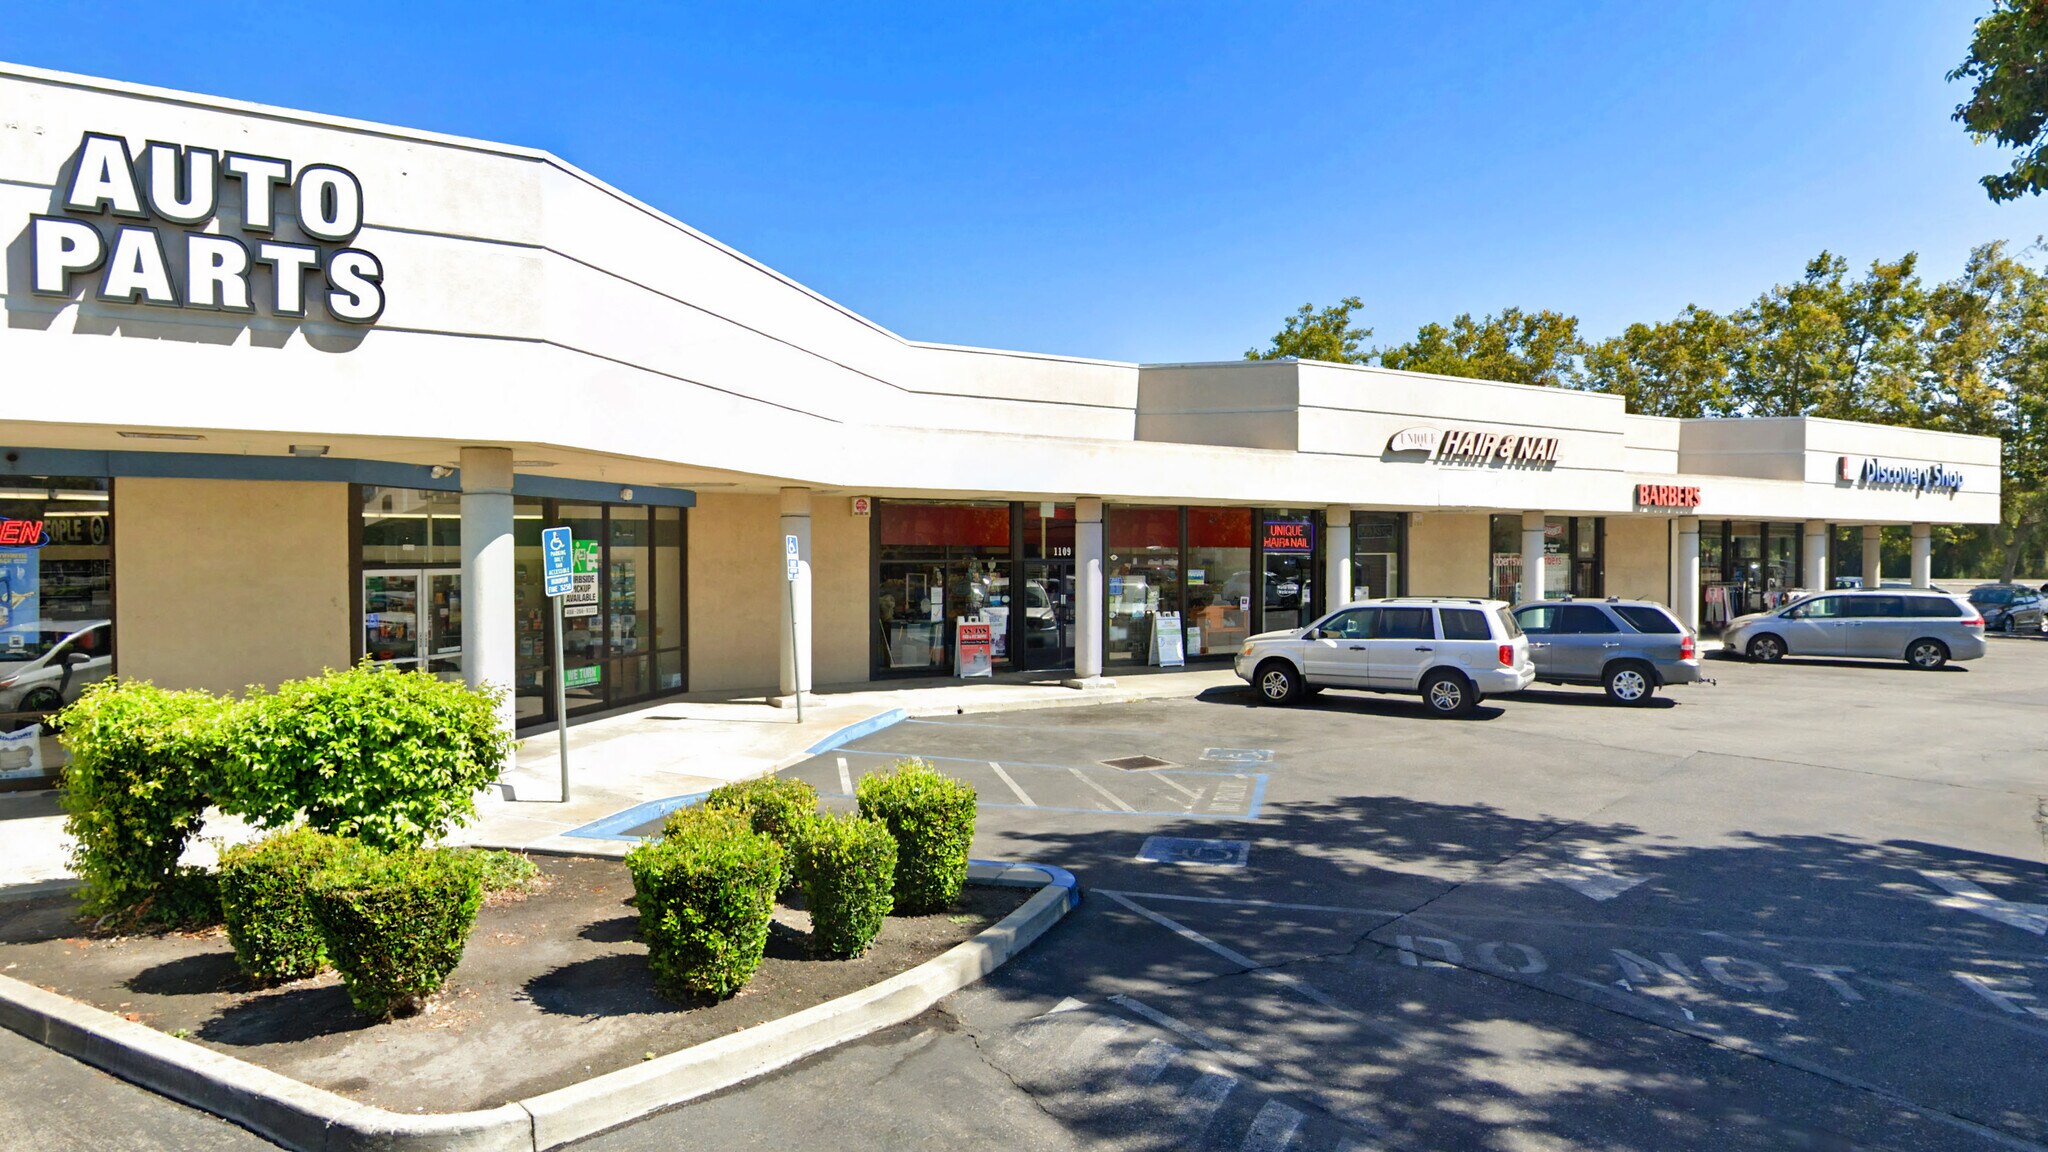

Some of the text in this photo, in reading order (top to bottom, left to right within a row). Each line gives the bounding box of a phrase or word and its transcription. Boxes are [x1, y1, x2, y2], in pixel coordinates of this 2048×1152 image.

[63, 131, 363, 242] AUTO
[30, 213, 385, 324] PARTS
[1442, 430, 1499, 456] HAIR
[1499, 434, 1515, 458] &
[1517, 436, 1563, 461] NAIL
[1862, 458, 1963, 493] Discovery Shop
[1637, 484, 1701, 507] BARBERS
[0, 520, 43, 544] EN
[44, 519, 82, 541] EOPLE
[1270, 525, 1304, 537] UNIQUE
[1054, 547, 1071, 556] 1109
[1290, 538, 1310, 548] NAIL
[566, 593, 596, 603] AVAILABLE
[1396, 935, 1866, 1001] DO NOT
